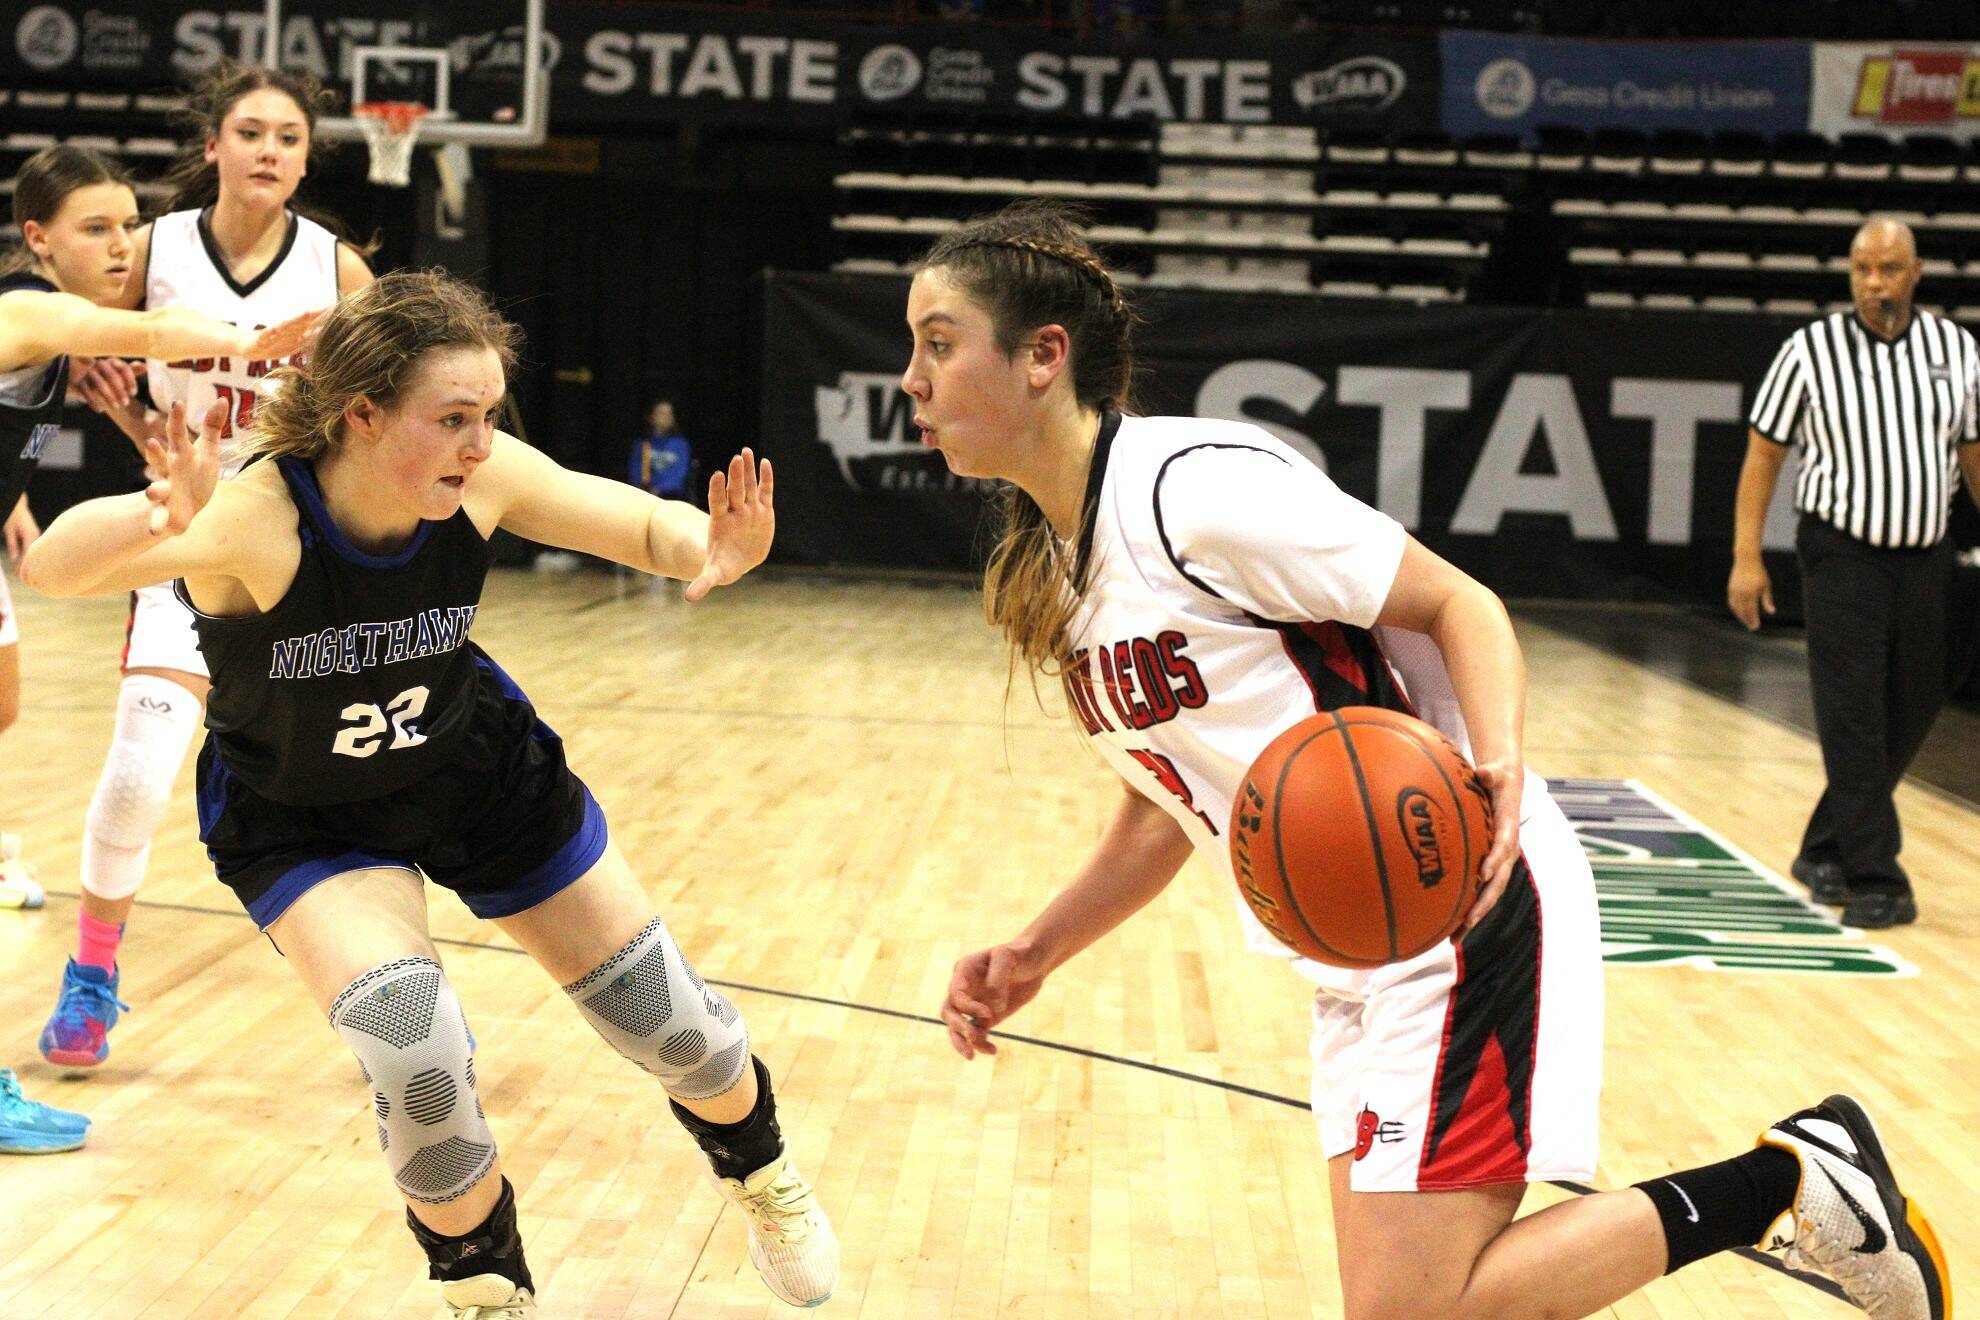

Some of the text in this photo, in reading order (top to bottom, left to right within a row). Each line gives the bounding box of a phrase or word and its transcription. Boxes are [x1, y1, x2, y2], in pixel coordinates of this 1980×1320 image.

[583, 31, 839, 102] STATE
[1017, 51, 1271, 121] STATE
[332, 685, 430, 758] 22
[1411, 801, 1444, 890] WIAA
